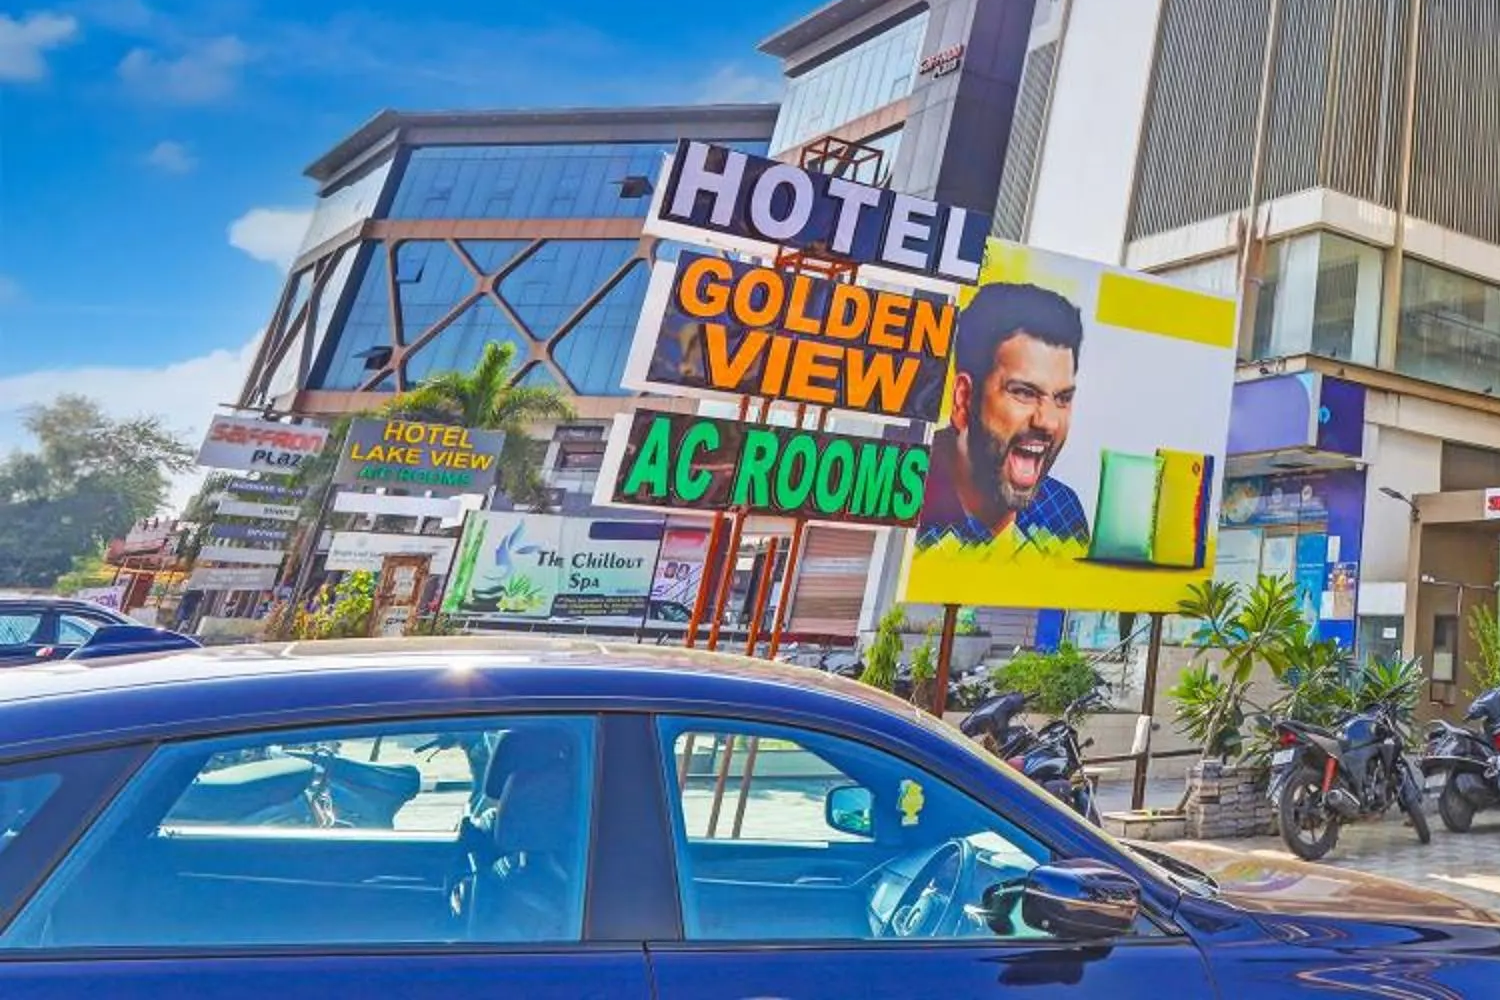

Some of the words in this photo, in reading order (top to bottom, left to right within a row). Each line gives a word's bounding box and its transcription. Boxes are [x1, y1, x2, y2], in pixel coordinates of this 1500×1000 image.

[669, 140, 981, 280] HOTEL
[678, 256, 956, 358] GOLDEN
[704, 322, 921, 414] VIEW
[351, 442, 423, 465] LAKE
[430, 450, 495, 471] VIEW
[383, 419, 474, 449] HOTEL
[623, 416, 720, 501] AC
[733, 429, 930, 520] ROOMS
